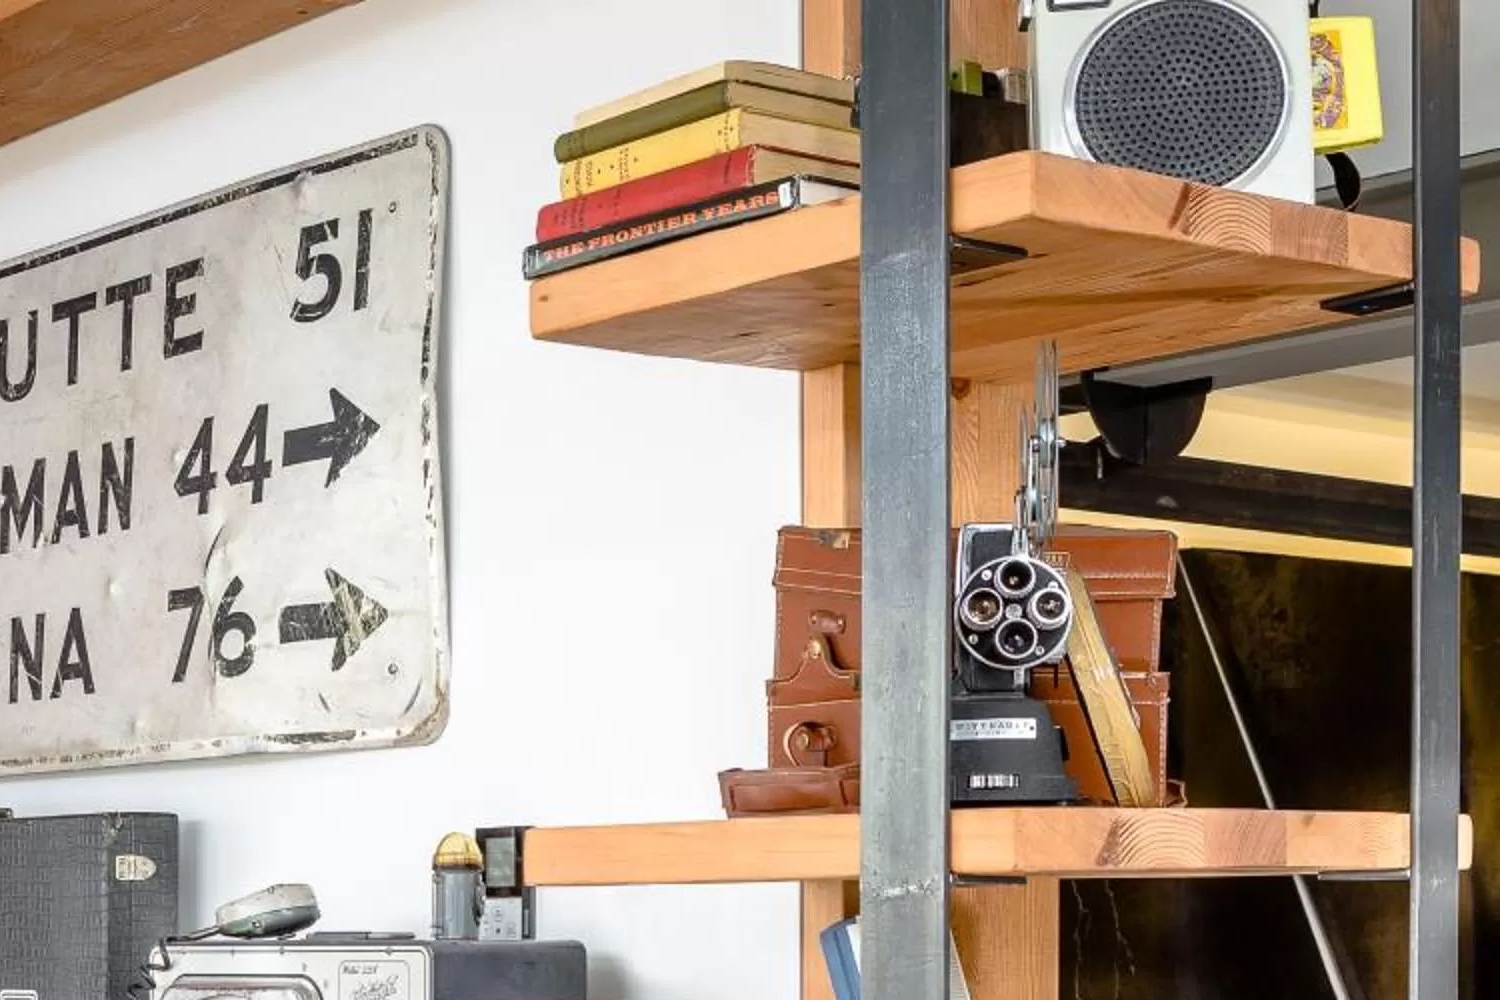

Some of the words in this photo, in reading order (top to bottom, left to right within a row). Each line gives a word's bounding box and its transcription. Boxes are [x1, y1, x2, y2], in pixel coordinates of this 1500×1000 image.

[290, 208, 374, 324] 51
[544, 240, 584, 261] THE
[586, 213, 698, 249] FRONTIER
[702, 191, 780, 221] YEARS
[173, 403, 273, 515] 44
[167, 575, 257, 684] 76
